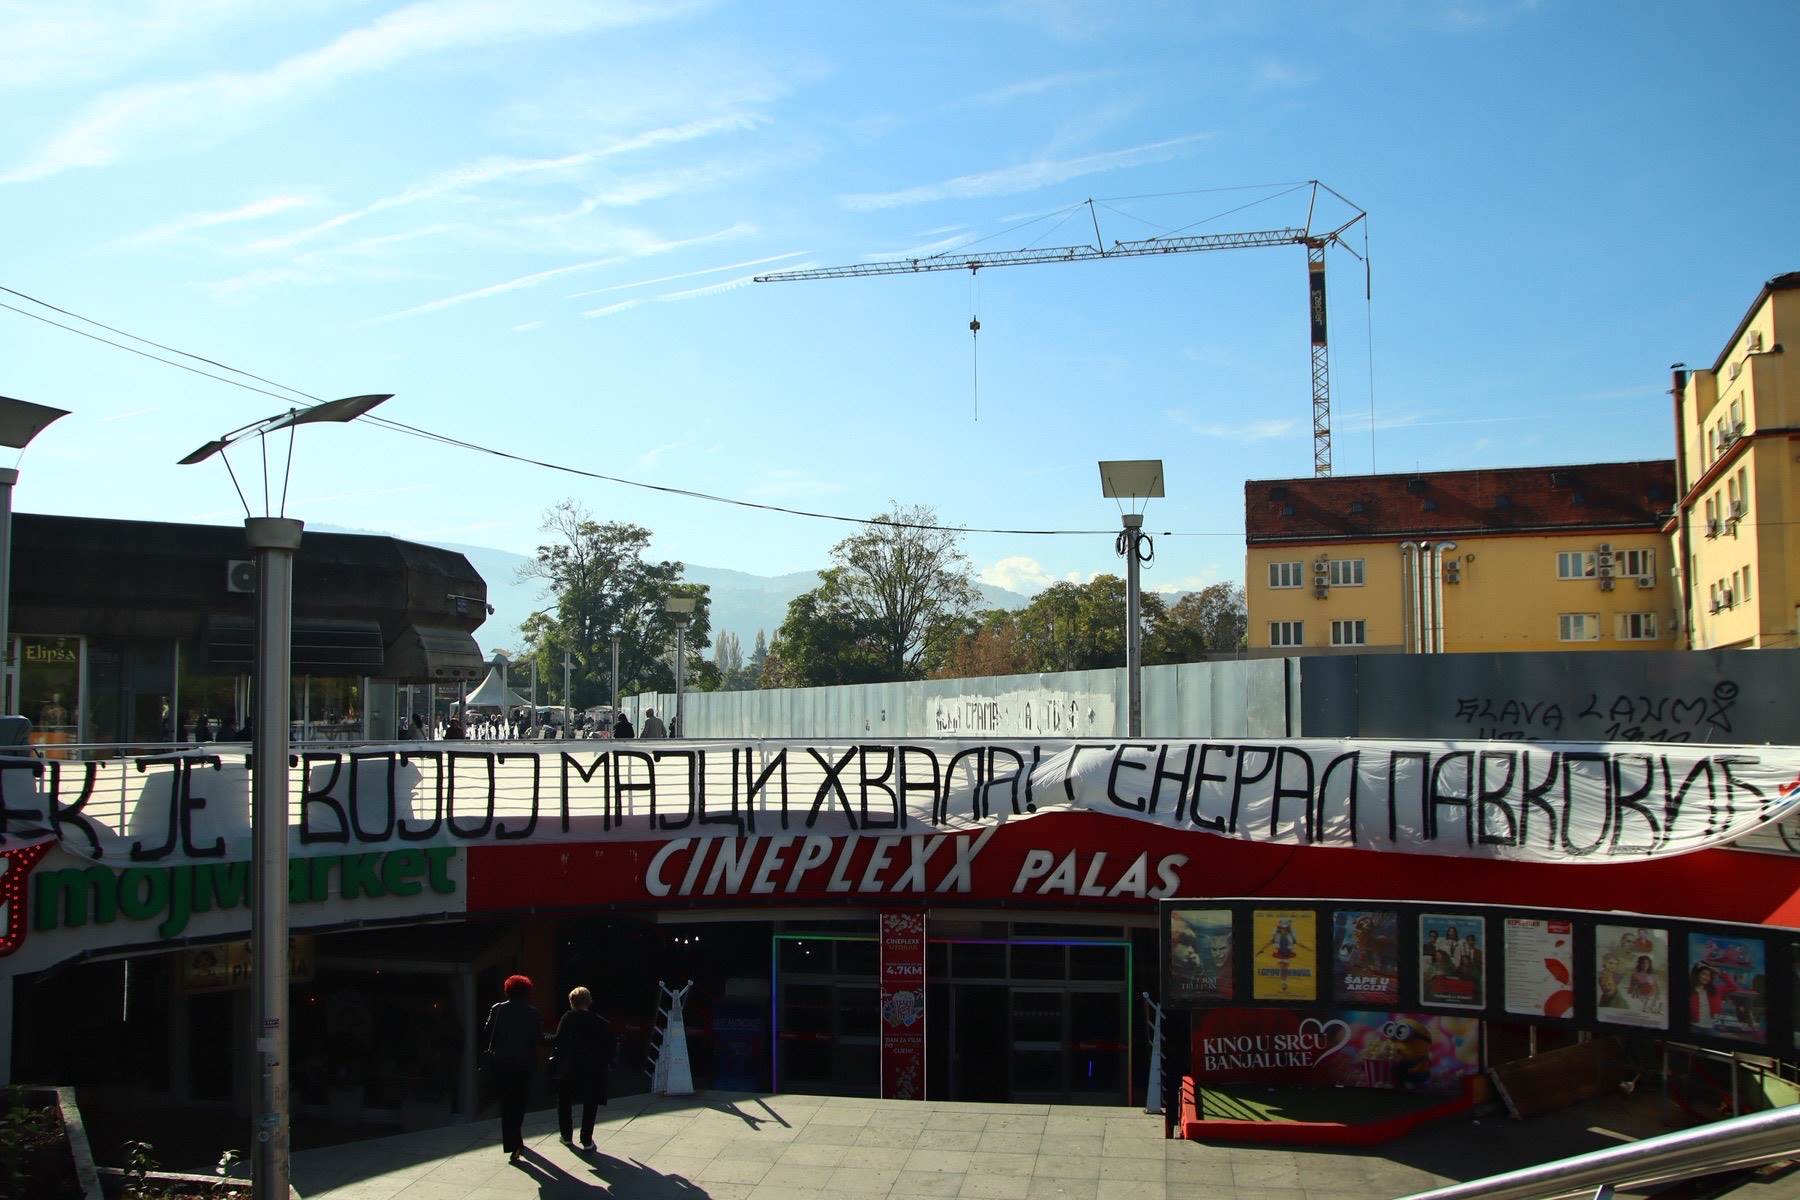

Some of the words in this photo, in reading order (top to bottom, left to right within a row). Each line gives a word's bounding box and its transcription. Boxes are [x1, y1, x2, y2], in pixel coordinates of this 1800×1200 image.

[131, 755, 226, 861] ЈЕ
[560, 748, 789, 837] МАЈЦИ
[806, 746, 1040, 830] ХВАЛА!
[1064, 744, 1361, 846] ГЕНЕРАЛ
[1389, 750, 1770, 857] ПАВКОВИЋ
[645, 824, 1000, 897] CINEPLEXX
[1012, 848, 1190, 899] PALAS
[1343, 974, 1377, 985] ŠAPE
[1379, 976, 1391, 985] U
[1203, 1035, 1253, 1055] KINO
[1256, 1034, 1270, 1052] U
[1273, 1032, 1328, 1052] SRCU
[1204, 1051, 1313, 1071] BANJALUKE
